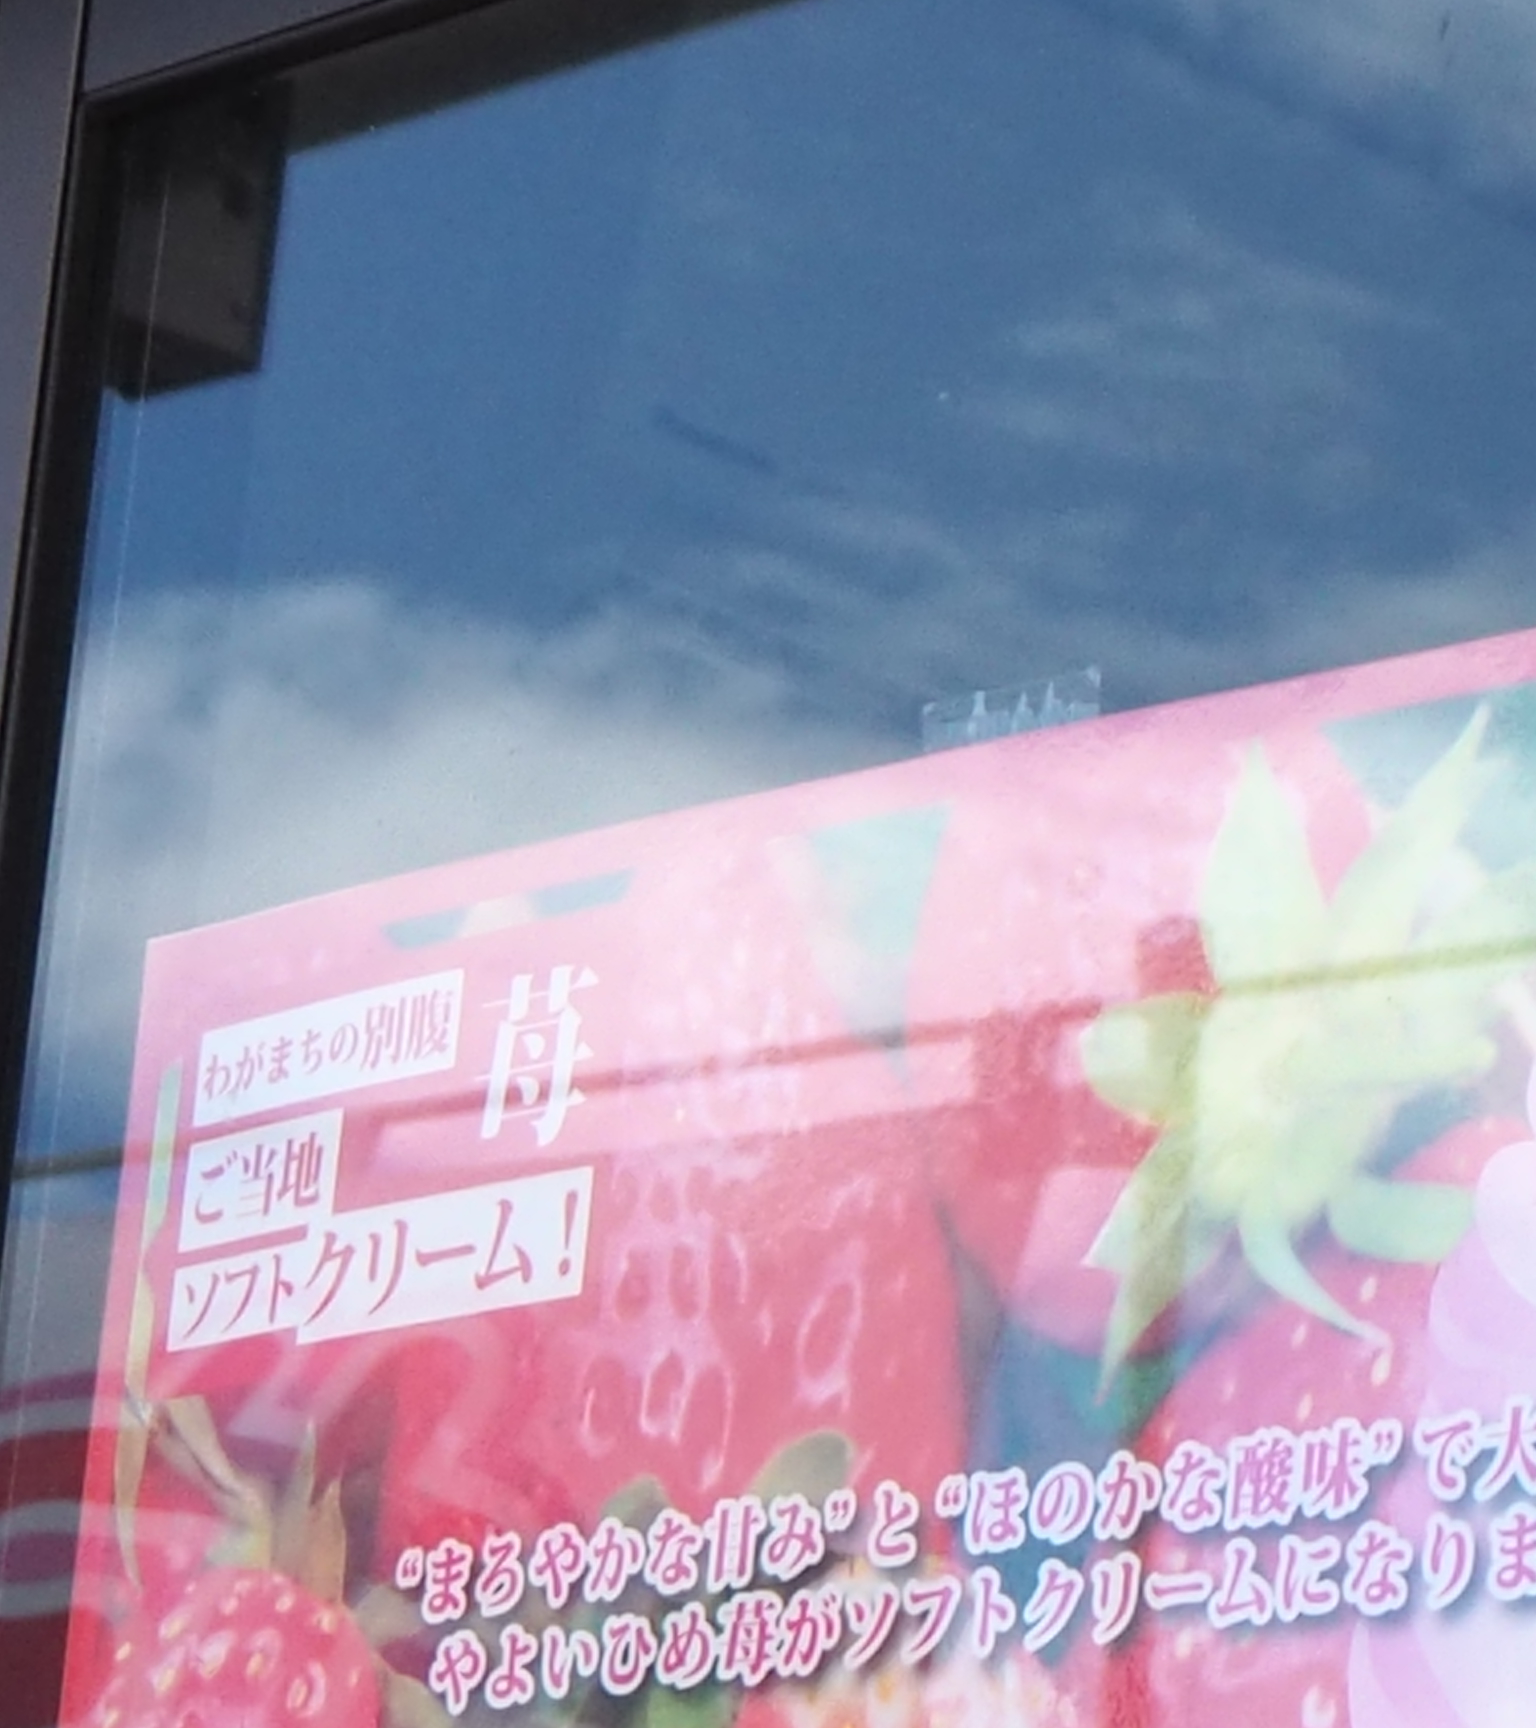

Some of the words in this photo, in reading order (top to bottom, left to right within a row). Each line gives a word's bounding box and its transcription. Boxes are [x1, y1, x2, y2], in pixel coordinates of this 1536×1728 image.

[203, 987, 455, 1099] わがまちの別腹
[474, 964, 599, 1147] 苺
[194, 1132, 325, 1225] ご当地
